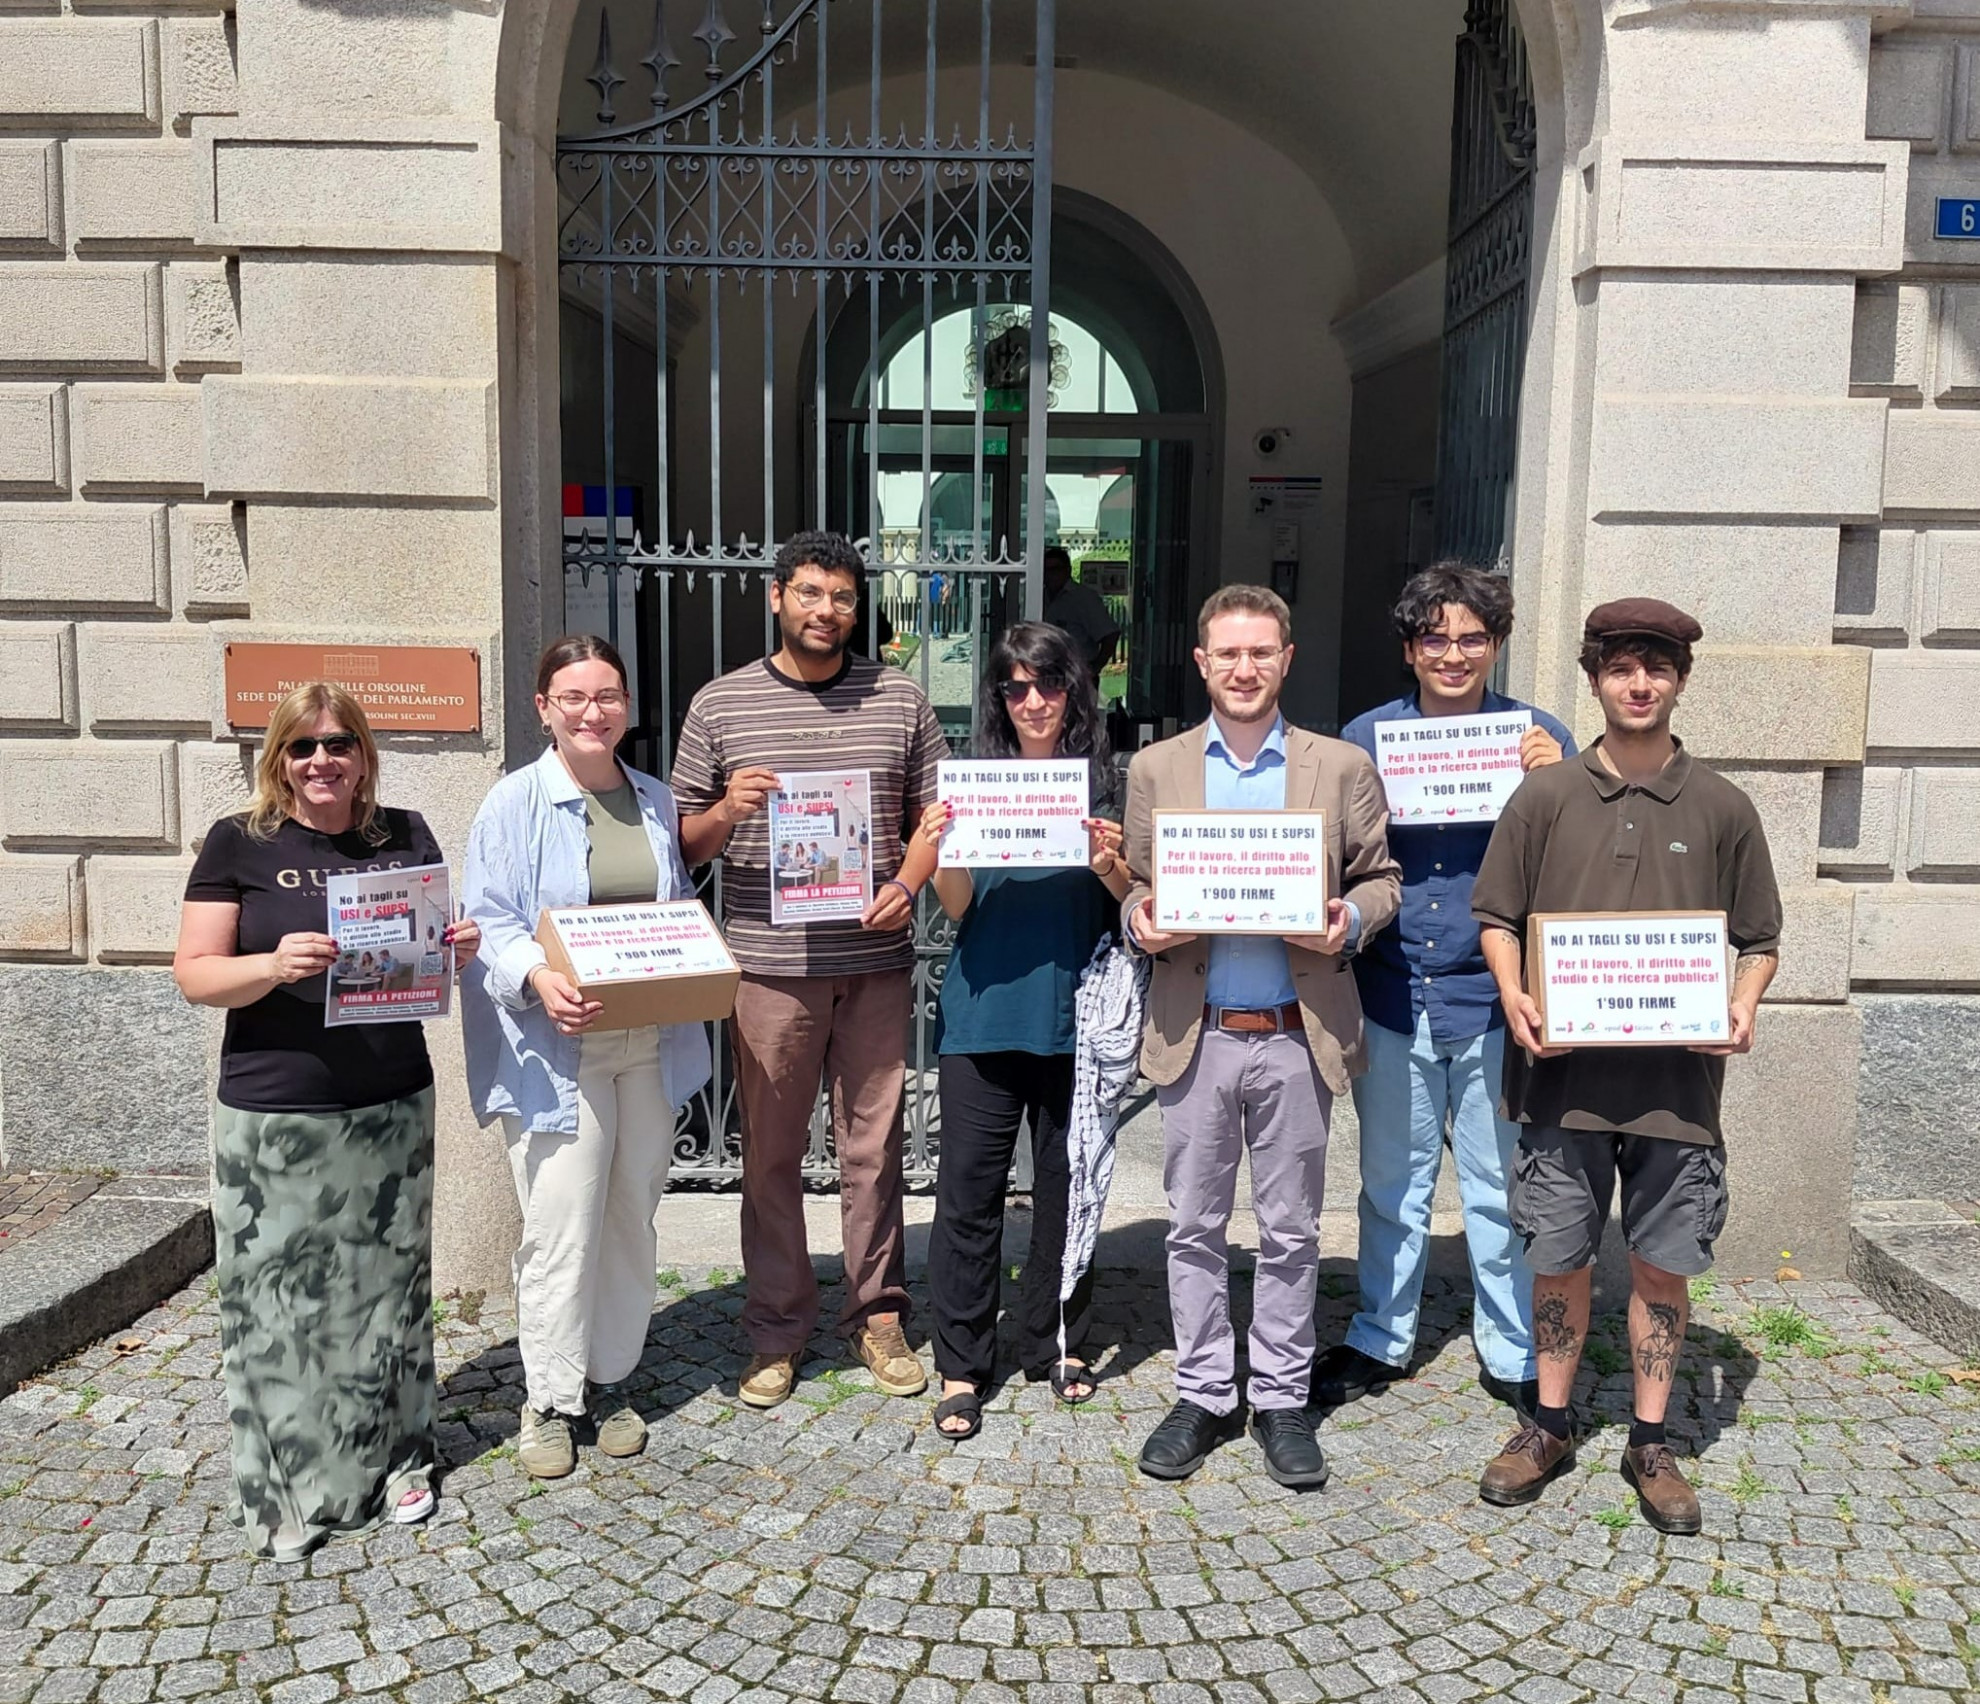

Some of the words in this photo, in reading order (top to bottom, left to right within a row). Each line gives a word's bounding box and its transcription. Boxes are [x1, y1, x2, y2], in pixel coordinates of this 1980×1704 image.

[1961, 203, 1975, 232] 6
[367, 683, 426, 693] ORSOLINE
[236, 692, 265, 702] SEDE
[363, 694, 385, 705] DEL
[388, 695, 465, 706] PARLAMENTO
[364, 712, 398, 720] RSOLINE
[1381, 733, 1395, 743] NO
[1400, 732, 1409, 742] AI
[1414, 730, 1442, 741] TAGLI
[1446, 728, 1460, 739] SU
[1464, 727, 1482, 737] USI
[1486, 725, 1491, 736] E
[1495, 723, 1526, 735] SUPSI
[1388, 754, 1404, 763] Per
[1408, 753, 1415, 762] il
[1418, 750, 1454, 761] lavoro,
[1457, 750, 1464, 759] il
[1467, 747, 1500, 758] diritto
[1383, 766, 1415, 776] studio
[1418, 766, 1424, 774] e
[1427, 764, 1437, 773] la
[1441, 761, 1478, 772] ricerca
[1481, 759, 1521, 770] pubblic
[943, 773, 957, 783] NO
[961, 772, 971, 783] AI
[975, 772, 1002, 783] TAGLI
[1005, 772, 1019, 783] SU
[1023, 772, 1039, 783] USI
[1043, 772, 1049, 782] E
[1052, 772, 1082, 782] SUPSI
[1423, 785, 1455, 796] 1'900
[1460, 782, 1492, 794] FIRME
[948, 794, 964, 803] Per
[967, 794, 974, 803] il
[977, 794, 1012, 805] lavoro,
[1015, 794, 1022, 803] il
[1025, 793, 1056, 803] diritto
[1059, 793, 1077, 803] allo
[977, 808, 983, 817] e
[986, 807, 995, 817] la
[999, 807, 1034, 816] ricerca
[980, 828, 1011, 839] 1'900
[1015, 828, 1047, 839] FIRME
[1162, 828, 1177, 838] NO
[1181, 828, 1192, 838] AI
[1197, 828, 1226, 839] TAGLI
[1230, 828, 1245, 839] SU
[1249, 828, 1268, 839] USI
[1272, 828, 1278, 839] E
[1282, 828, 1315, 839] SUPSI
[1168, 851, 1185, 861] Per
[1189, 851, 1196, 861] il
[1199, 851, 1237, 862] lavoro,
[1240, 851, 1248, 861] il
[1252, 851, 1285, 862] diritto
[1289, 851, 1310, 862] allo
[1161, 865, 1195, 875] studio
[1199, 866, 1205, 875] e
[1209, 865, 1218, 875] la
[1222, 865, 1261, 875] ricerca
[1265, 865, 1316, 876] pubblica!
[339, 896, 353, 906] No
[357, 894, 366, 904] ai
[370, 890, 393, 903] tagli
[396, 889, 408, 899] su
[1202, 888, 1236, 900] 1'900
[1241, 888, 1275, 900] FIRME
[340, 908, 360, 921] USI
[364, 909, 372, 918] e
[558, 917, 574, 926] NO
[577, 916, 588, 925] AI
[591, 915, 620, 924] TAGLI
[622, 913, 637, 922] SU
[639, 911, 657, 920] USI
[660, 911, 666, 919] E
[669, 909, 700, 918] SUPSI
[1550, 935, 1567, 946] NO
[1572, 934, 1583, 946] AI
[1588, 934, 1620, 946] TAGLI
[1625, 933, 1641, 945] SU
[1645, 933, 1665, 945] USI
[1670, 933, 1677, 944] E
[1681, 932, 1717, 944] SUPSI
[614, 951, 648, 960] 1'900
[650, 947, 684, 957] FIRME
[1557, 959, 1576, 970] Per
[1580, 958, 1588, 970] il
[1592, 958, 1633, 970] lavoro,
[1637, 958, 1645, 969] il
[1649, 957, 1686, 969] diritto
[1690, 957, 1712, 968] allo
[1551, 973, 1588, 985] studio
[1592, 975, 1599, 984] e
[1603, 973, 1614, 984] la
[1618, 972, 1660, 983] ricerca
[1664, 971, 1720, 984] pubblica!
[343, 994, 373, 1004] FIRMA
[376, 993, 388, 1002] LA
[391, 989, 437, 1001] PETIZIONE
[1596, 997, 1633, 1009] 1'900
[1639, 997, 1677, 1009] FIRME
